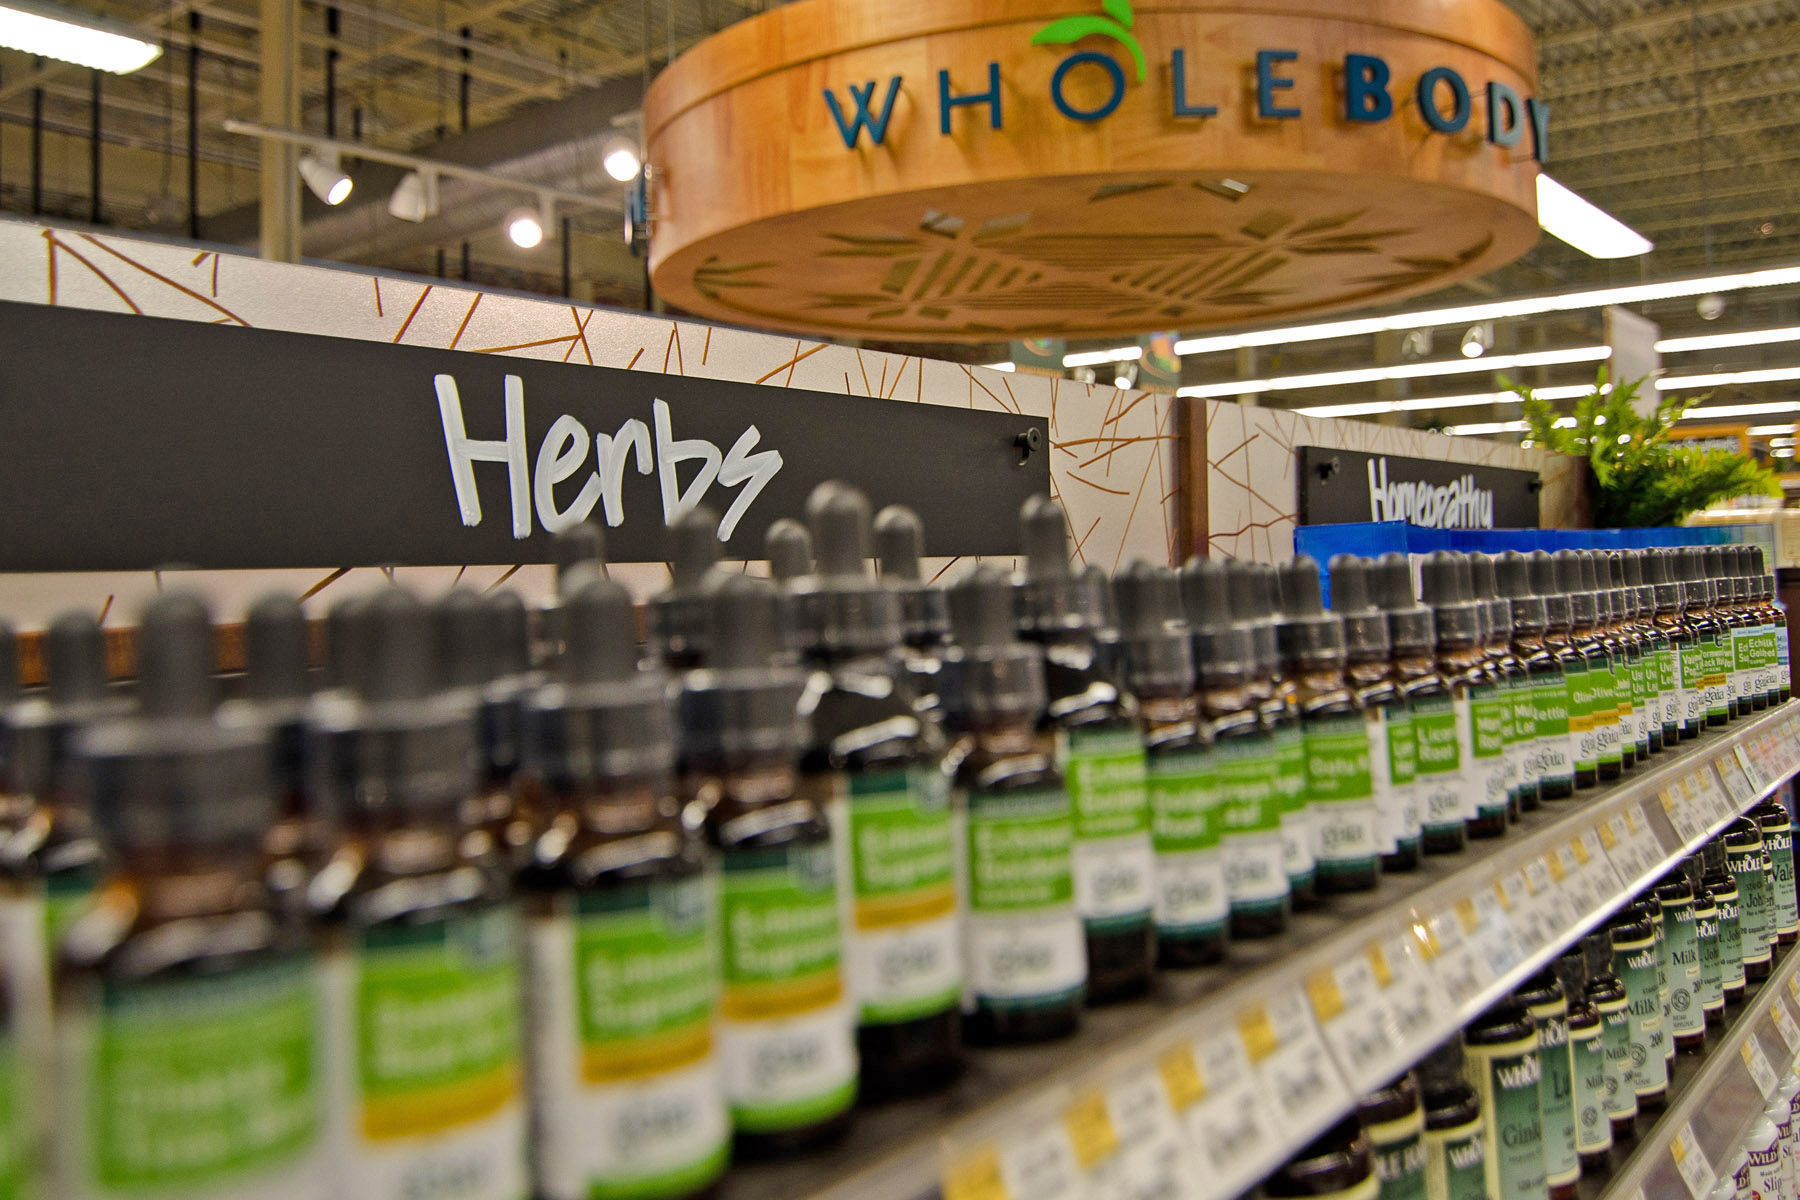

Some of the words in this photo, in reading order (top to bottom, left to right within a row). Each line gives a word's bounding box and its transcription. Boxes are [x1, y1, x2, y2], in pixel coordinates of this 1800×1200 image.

[434, 374, 783, 541] Herbs
[1704, 686, 1725, 707] gaia
[1672, 949, 1697, 966] Milk
[1628, 998, 1656, 1016] Milk
[1749, 1151, 1778, 1166] WILD
